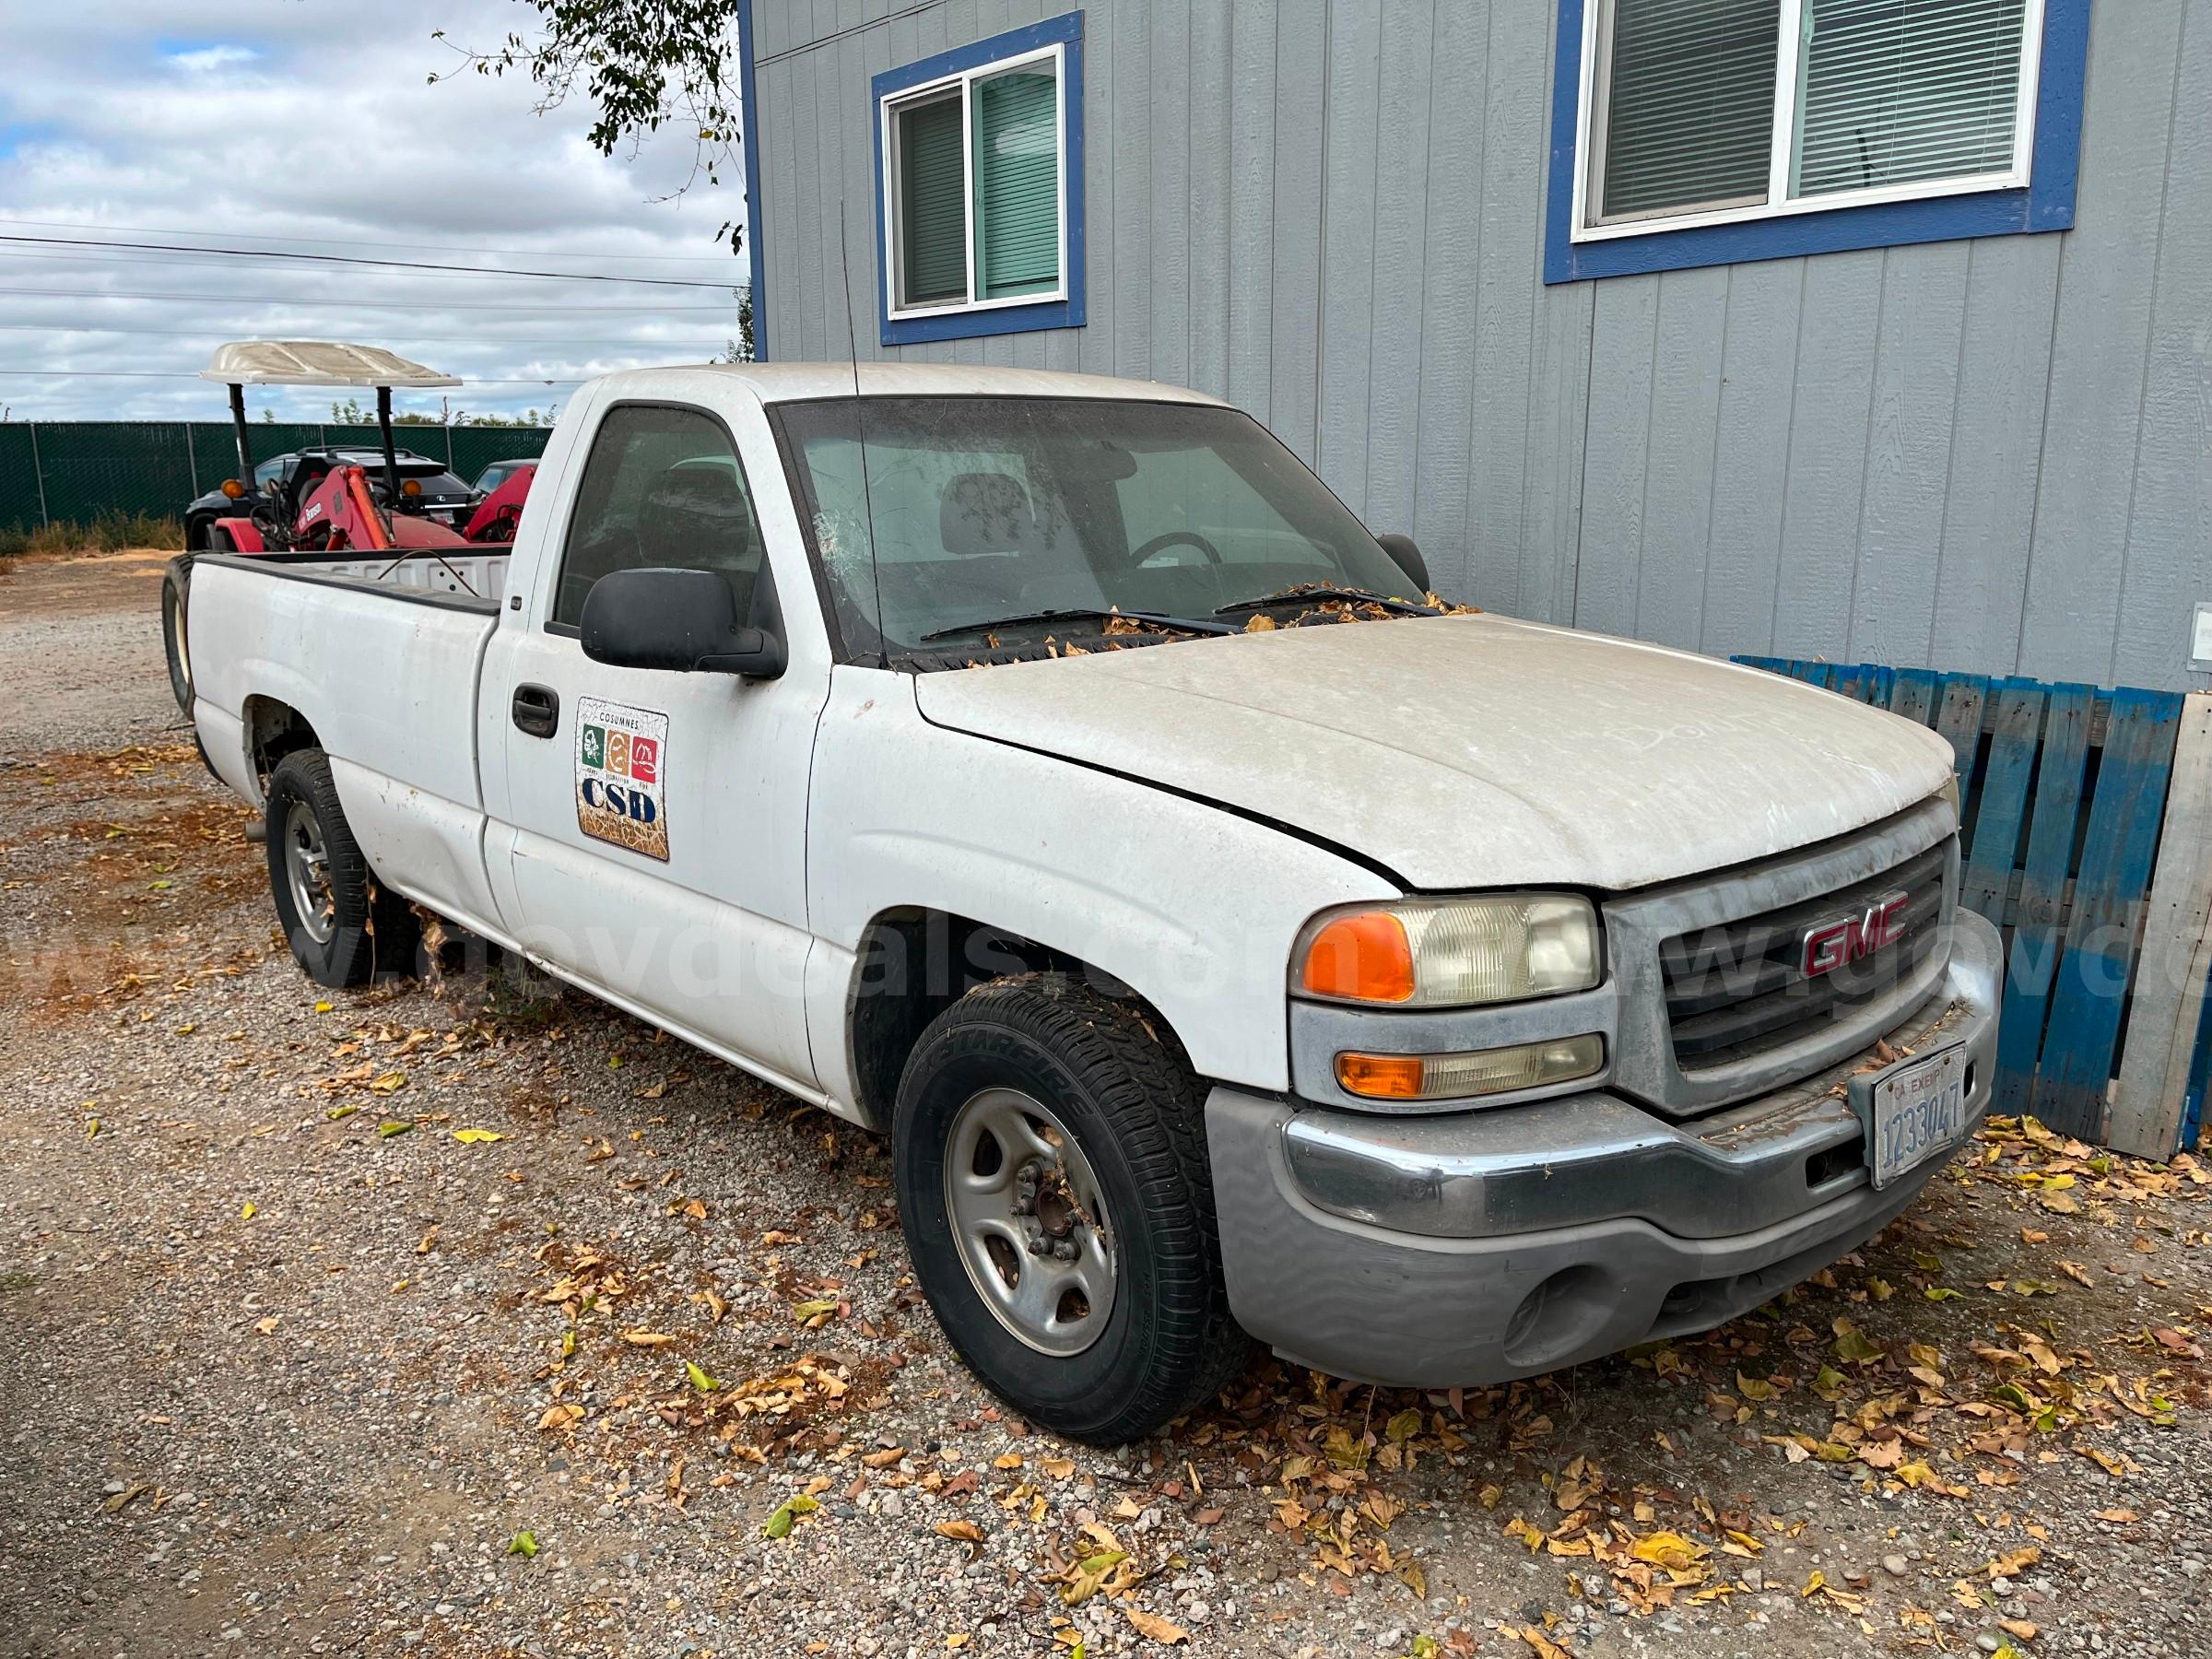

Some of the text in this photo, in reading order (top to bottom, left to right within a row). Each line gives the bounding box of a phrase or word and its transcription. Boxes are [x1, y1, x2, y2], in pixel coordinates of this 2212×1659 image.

[600, 712, 640, 730] COSUMNES
[582, 777, 656, 823] CSD
[1800, 890, 1909, 979] GMC
[1912, 1067, 1945, 1093] EXEMPT
[1884, 1082, 1959, 1169] 1233047
